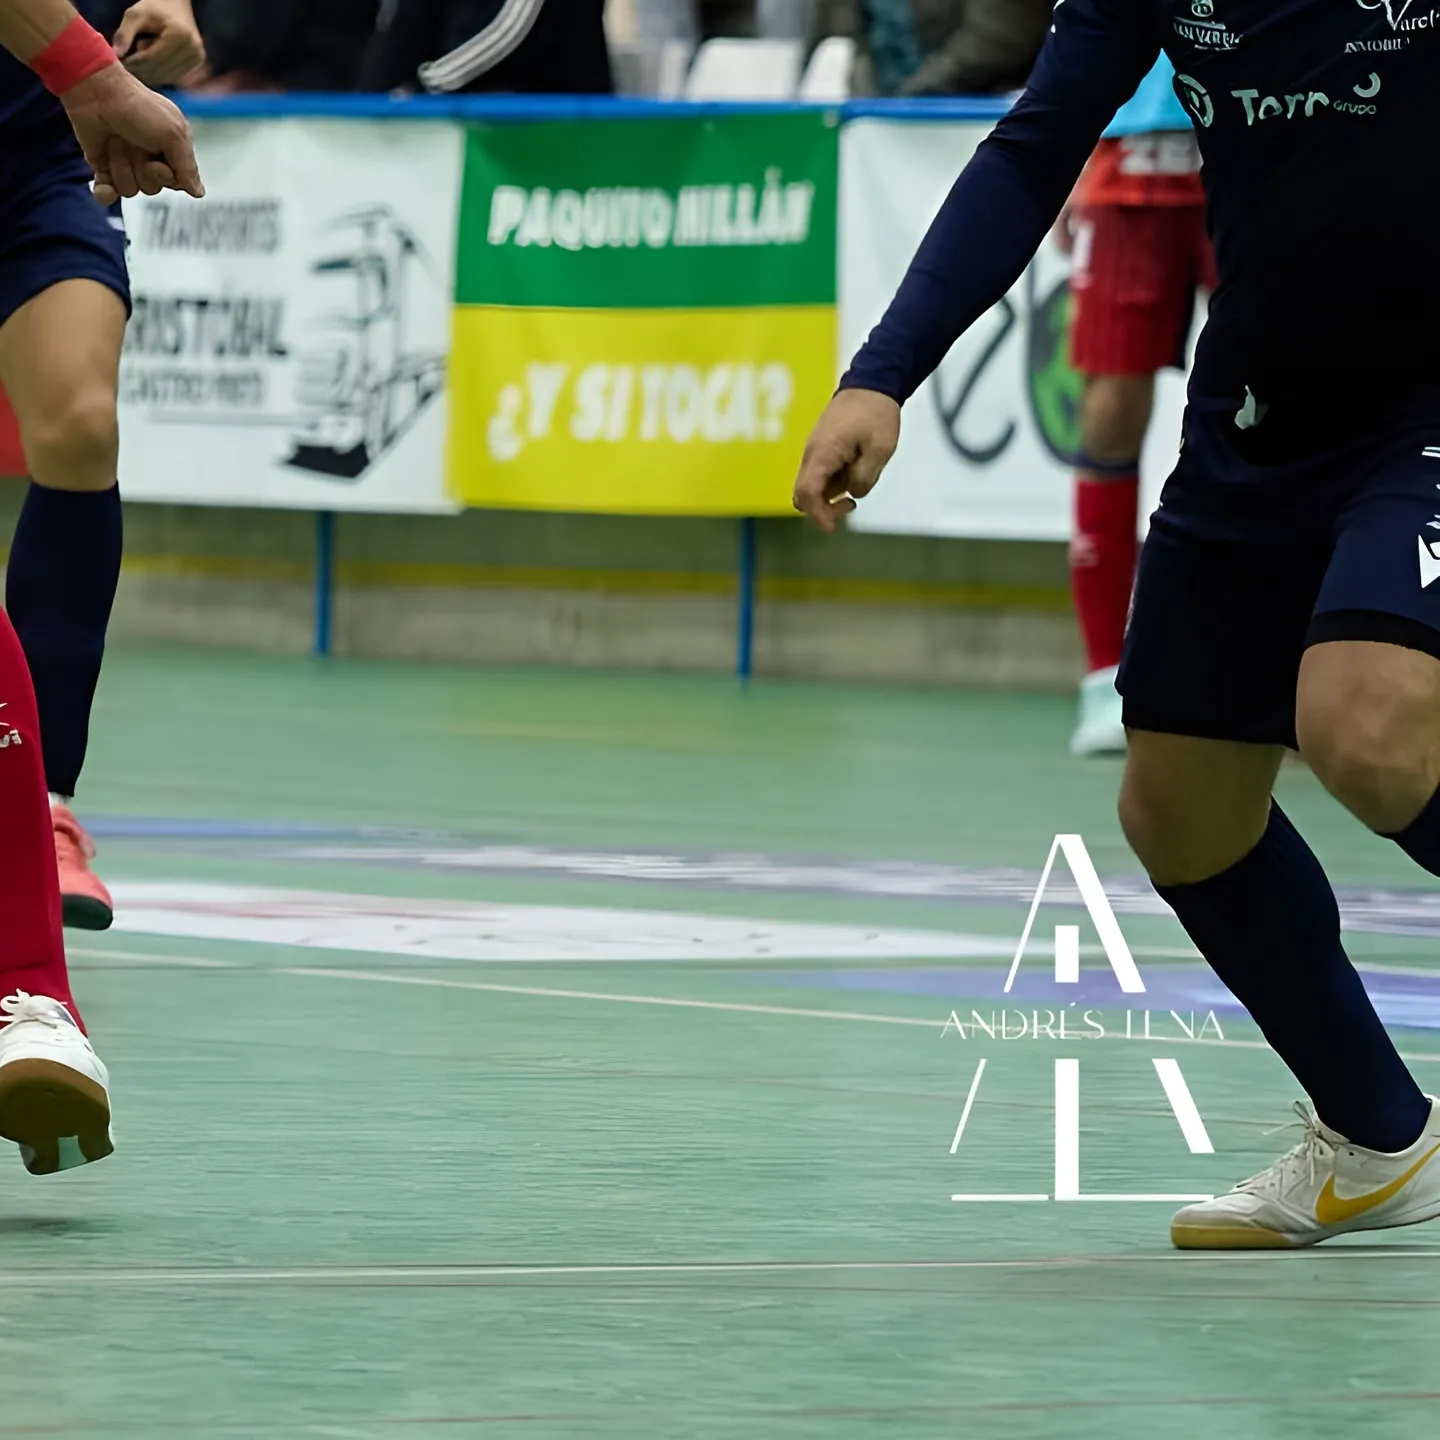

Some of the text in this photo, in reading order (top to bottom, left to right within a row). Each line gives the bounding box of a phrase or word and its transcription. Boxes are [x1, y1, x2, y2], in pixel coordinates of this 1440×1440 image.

[486, 184, 673, 251] PAQUITO
[569, 361, 637, 443] SI
[638, 360, 797, 444] TOCA?
